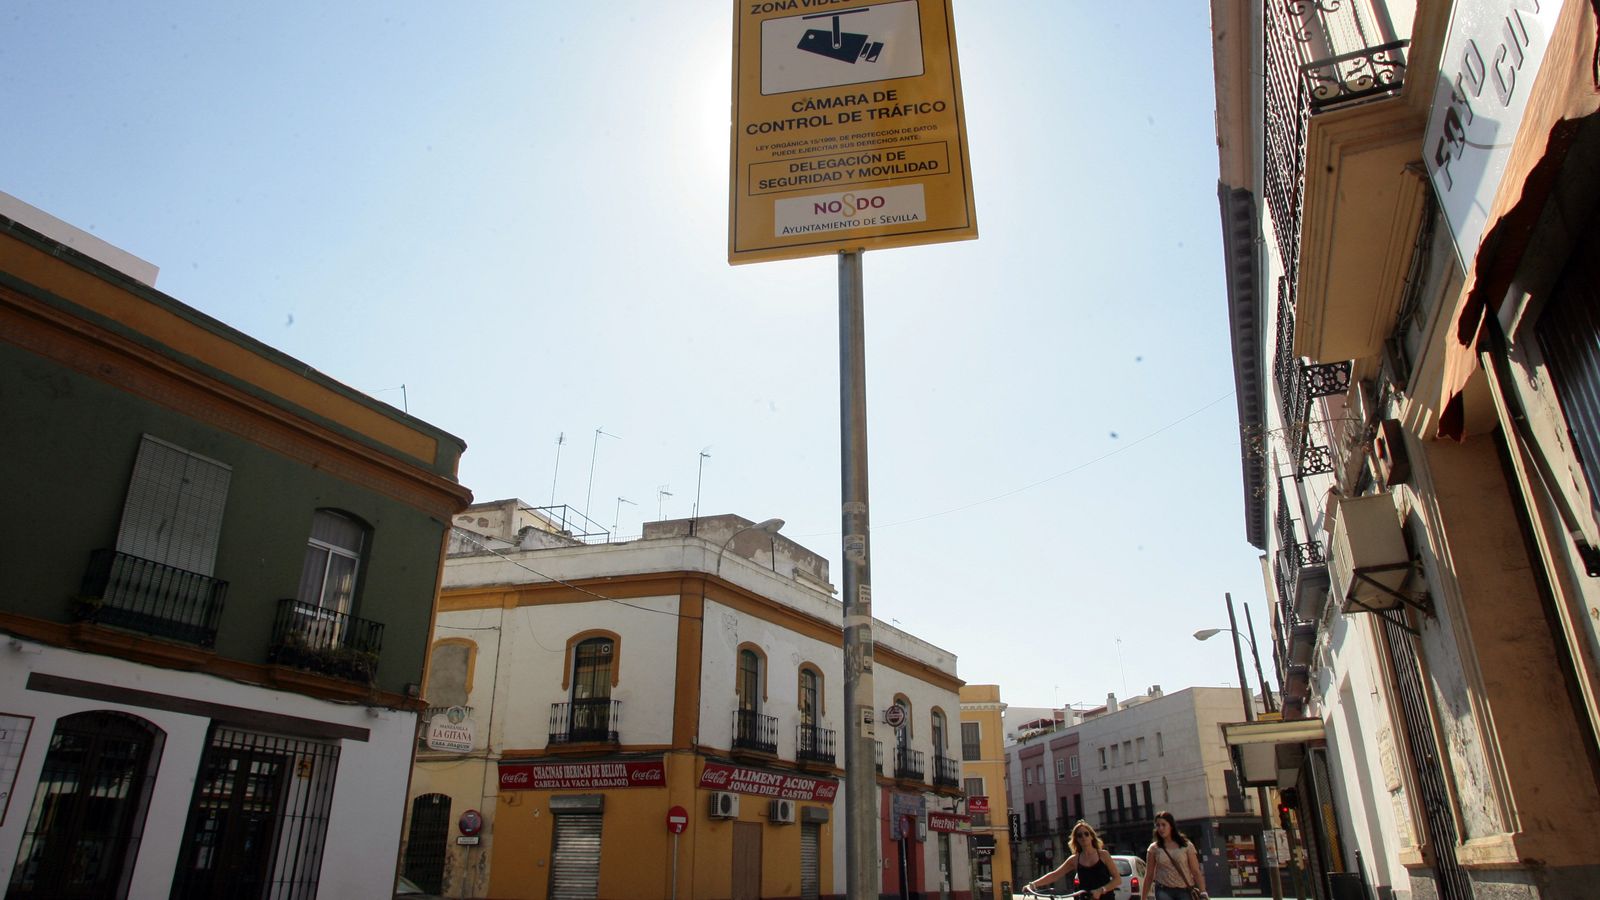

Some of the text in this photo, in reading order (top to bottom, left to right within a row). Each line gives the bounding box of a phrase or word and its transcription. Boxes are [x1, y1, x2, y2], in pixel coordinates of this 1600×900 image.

[750, 0, 798, 15] ZONA
[791, 90, 897, 114] CÁMARA DE
[746, 100, 947, 135] CONTROL DE TRÁFICO
[755, 143, 770, 151] LEY
[913, 124, 938, 132] DATOS
[772, 148, 797, 157] PUEDE
[798, 144, 839, 153] EJERCITAR
[856, 137, 898, 148] DERECHOS
[789, 151, 906, 173] DELEGACIÓN DE
[758, 160, 939, 190] SEGURIDAD Y MOVILIDAD
[863, 217, 877, 225] DE
[433, 729, 472, 742] LA GITANA
[533, 763, 628, 780] CHACINAS IBERICAS DE BELLOTA
[730, 768, 816, 791] ALIMENT ACION
[534, 778, 629, 788] CABEZA LA VACA (BADAJOZ)
[727, 781, 814, 800] JONAS DIEZ CASTRO
